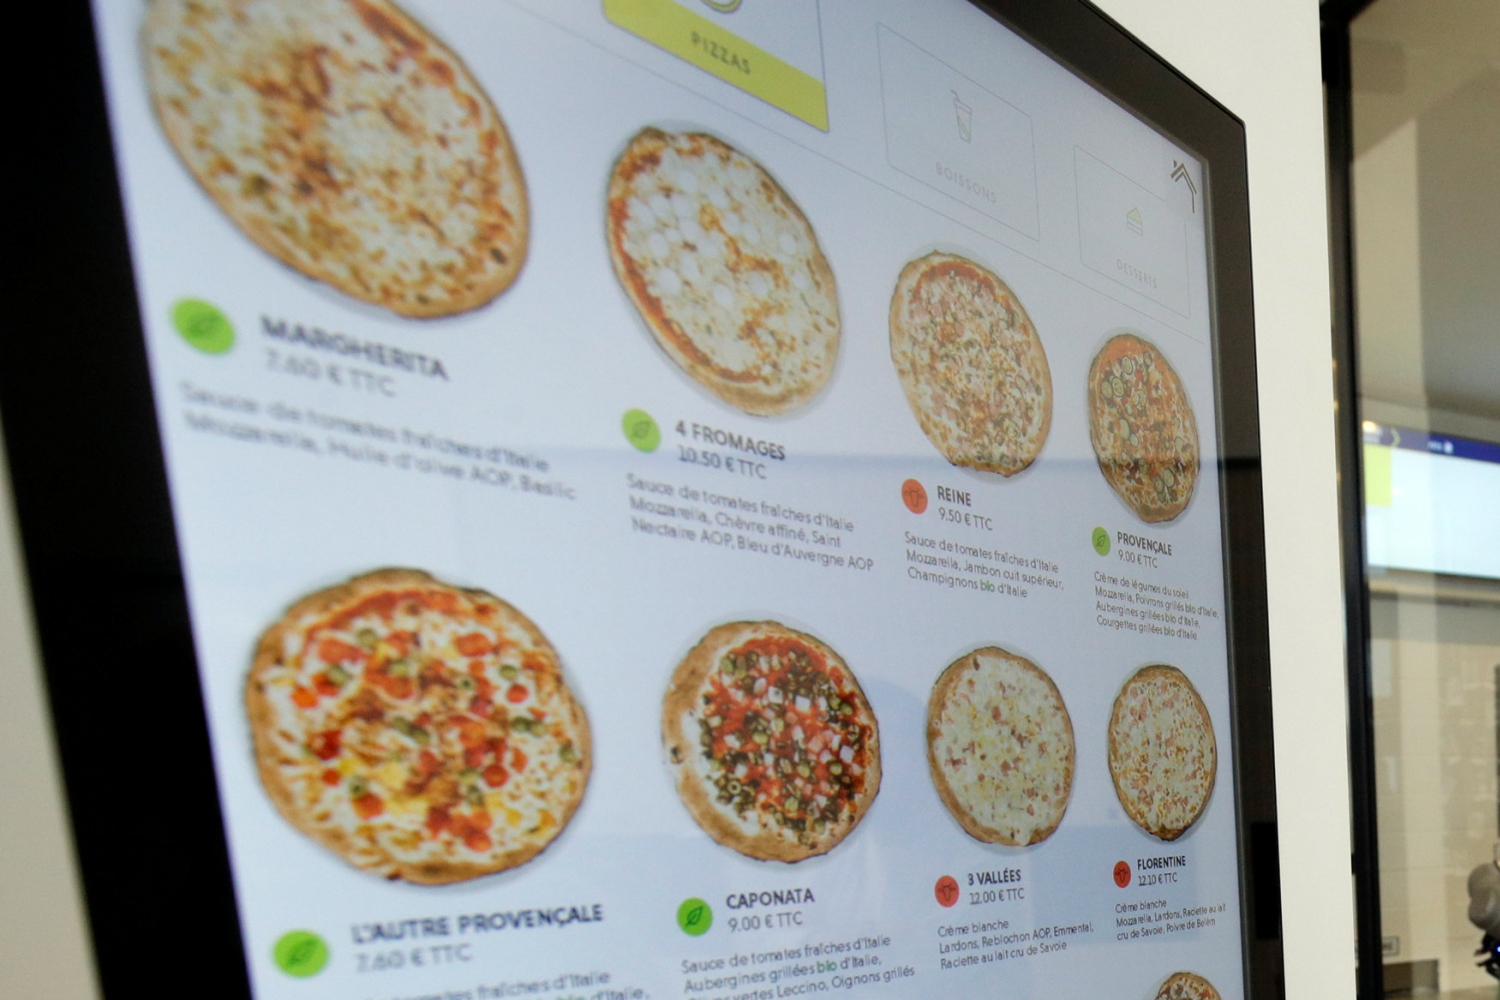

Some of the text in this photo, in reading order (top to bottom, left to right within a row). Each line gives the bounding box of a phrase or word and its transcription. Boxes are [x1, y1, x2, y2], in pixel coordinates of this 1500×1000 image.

[692, 31, 752, 76] PIZZAS
[936, 162, 996, 204] BOISSONS
[1117, 259, 1157, 289] DESSERTS
[260, 314, 449, 380] MARGHERITA
[675, 421, 786, 460] 4 FROMAGES
[678, 445, 765, 479] 10.50 € TTC
[937, 486, 971, 507] REINE
[938, 507, 993, 531] 9.50 € TTC
[905, 531, 1058, 574] Sauce de tomates fraîches d'Italie
[1117, 531, 1172, 556] PROVENÇALE
[906, 549, 1063, 590] Mozzarella, Jambon cuit supérieur,
[1118, 549, 1157, 569] 9.00 € TTC
[907, 566, 1027, 598] Champignons bio d'Italie
[968, 868, 1021, 886] 3 VALLÉES
[1138, 856, 1186, 870] FLORENTINE
[1138, 872, 1177, 887] 12.10 € TTC
[726, 888, 815, 910] CAPONATA
[970, 887, 1024, 905] 12.00 € TTC
[459, 904, 602, 932] PROVENÇALE
[727, 911, 802, 933] 9.00 € TTC
[937, 920, 1009, 937] Crème blanche
[429, 943, 471, 964] TTC
[682, 937, 890, 974] Sauce de tomates fraîches d'Italie
[684, 955, 881, 993] Aubergines grillées bio d'Italie,
[776, 981, 829, 998] Leccino,
[831, 973, 881, 989] Oignons
[883, 966, 915, 983] grillés
